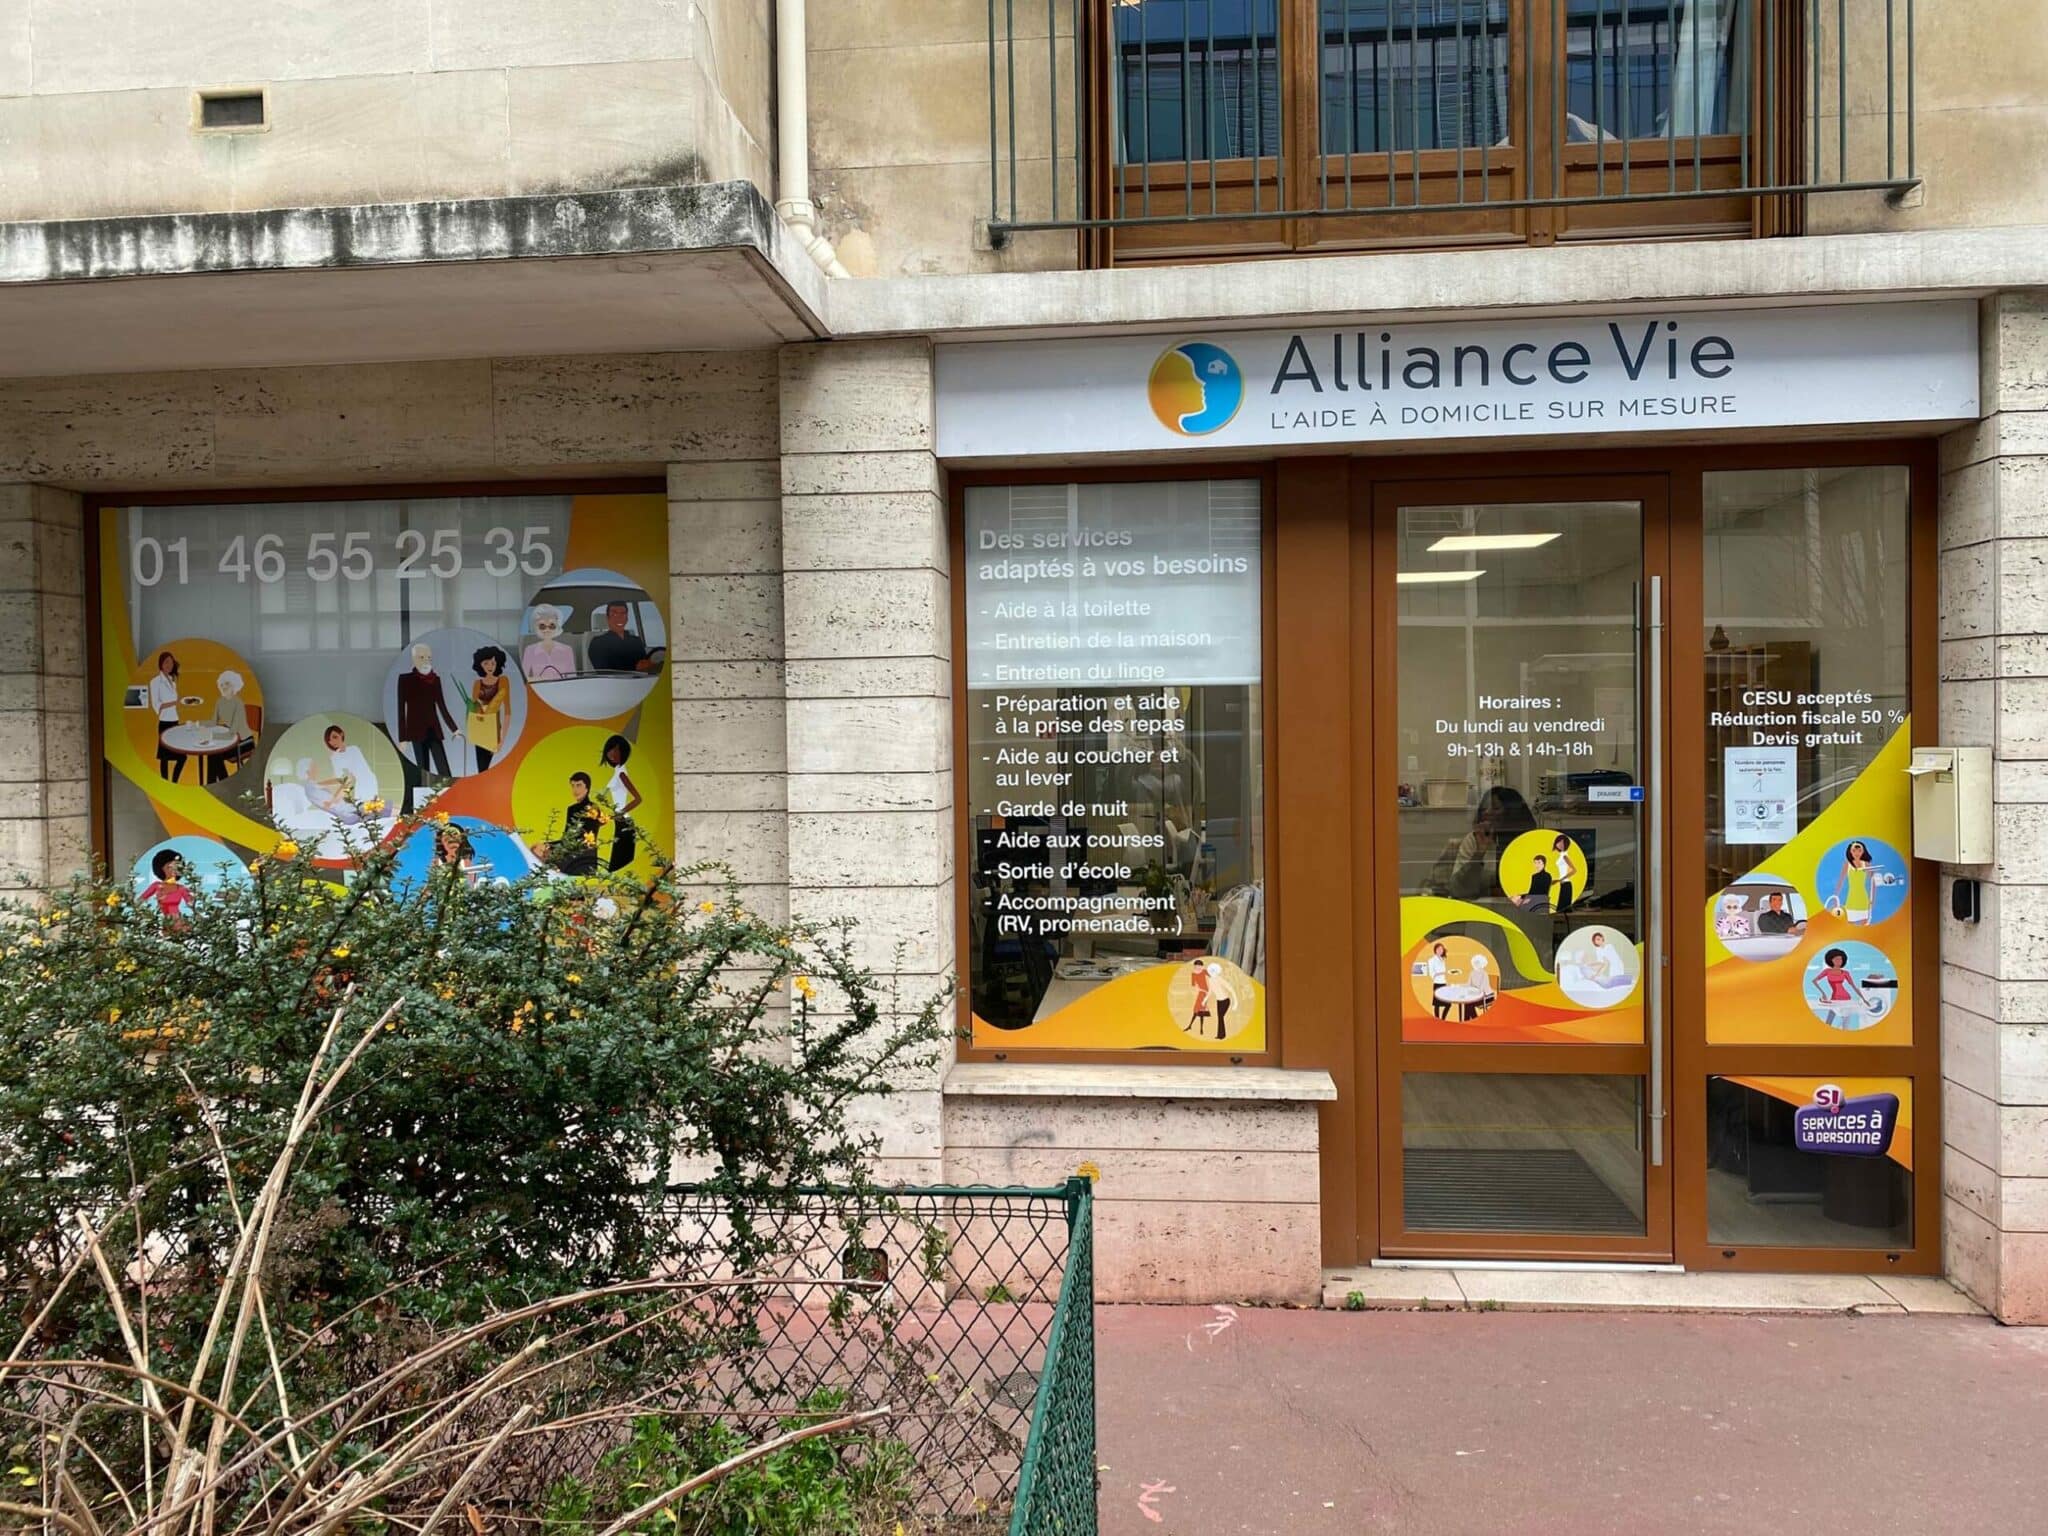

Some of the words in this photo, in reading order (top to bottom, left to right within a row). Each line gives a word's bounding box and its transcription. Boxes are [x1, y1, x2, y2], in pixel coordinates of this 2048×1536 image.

[1270, 332, 1591, 394] Alliance
[1608, 321, 1734, 380] Vie
[1272, 409, 1357, 429] L'AIDE
[1369, 402, 1387, 425] À
[1402, 403, 1534, 424] DOMICILE
[1548, 401, 1604, 419] SUR
[1620, 396, 1736, 416] MESURE
[980, 530, 1024, 550] Des
[1033, 528, 1133, 547] services
[132, 537, 189, 586] 01
[218, 533, 286, 583] 46
[307, 532, 373, 581] 55
[395, 529, 463, 579] 25
[484, 526, 553, 577] 35
[980, 557, 1074, 583] adaptés
[1082, 557, 1096, 577] à
[1104, 560, 1145, 577] vos
[1153, 554, 1247, 575] besoins
[995, 601, 1037, 618] Aide
[1044, 601, 1055, 618] à
[1062, 601, 1076, 617] la
[1084, 600, 1151, 617] toilette
[996, 632, 1080, 649] Entretien
[1088, 631, 1111, 648] de
[1118, 631, 1134, 647] la
[1141, 630, 1211, 647] maison
[996, 664, 1080, 681] Entretien
[1088, 663, 1111, 680] du
[1119, 662, 1165, 682] linge
[996, 695, 1107, 715] Préparation
[1114, 695, 1133, 710] et
[1138, 693, 1180, 710] aide
[1479, 695, 1551, 709] Horaires
[1743, 691, 1791, 706] CESU
[1797, 689, 1872, 709] acceptés
[996, 718, 1007, 734] à
[1013, 718, 1029, 733] la
[1036, 717, 1082, 737] prise
[1089, 717, 1123, 733] des
[1131, 719, 1185, 736] repas
[1436, 720, 1458, 734] Du
[1464, 719, 1503, 733] lundi
[1508, 721, 1528, 732] au
[1534, 718, 1605, 732] vendredi
[1711, 711, 1797, 726] Réduction
[1802, 711, 1856, 725] fiscale
[1862, 711, 1882, 724] 50
[1888, 710, 1904, 723] %
[1447, 743, 1504, 757] 9h-13h
[1509, 743, 1521, 756] &
[1526, 742, 1593, 756] 14h-18h
[1753, 731, 1799, 745] Devis
[1806, 731, 1862, 749] gratuit
[996, 749, 1039, 764] Aide
[1046, 752, 1068, 764] au
[1075, 747, 1154, 763] coucher
[1160, 747, 1179, 762] et
[996, 773, 1019, 786] au
[1026, 770, 1072, 786] lever
[997, 801, 1055, 817] Garde
[1062, 800, 1085, 816] de
[1092, 800, 1128, 815] nuit
[997, 832, 1040, 848] Aide
[1046, 835, 1081, 847] aux
[1087, 834, 1164, 847] courses
[998, 863, 1054, 879] Sortie
[998, 894, 1176, 915] Accompagnement
[998, 915, 1033, 935] (RV,
